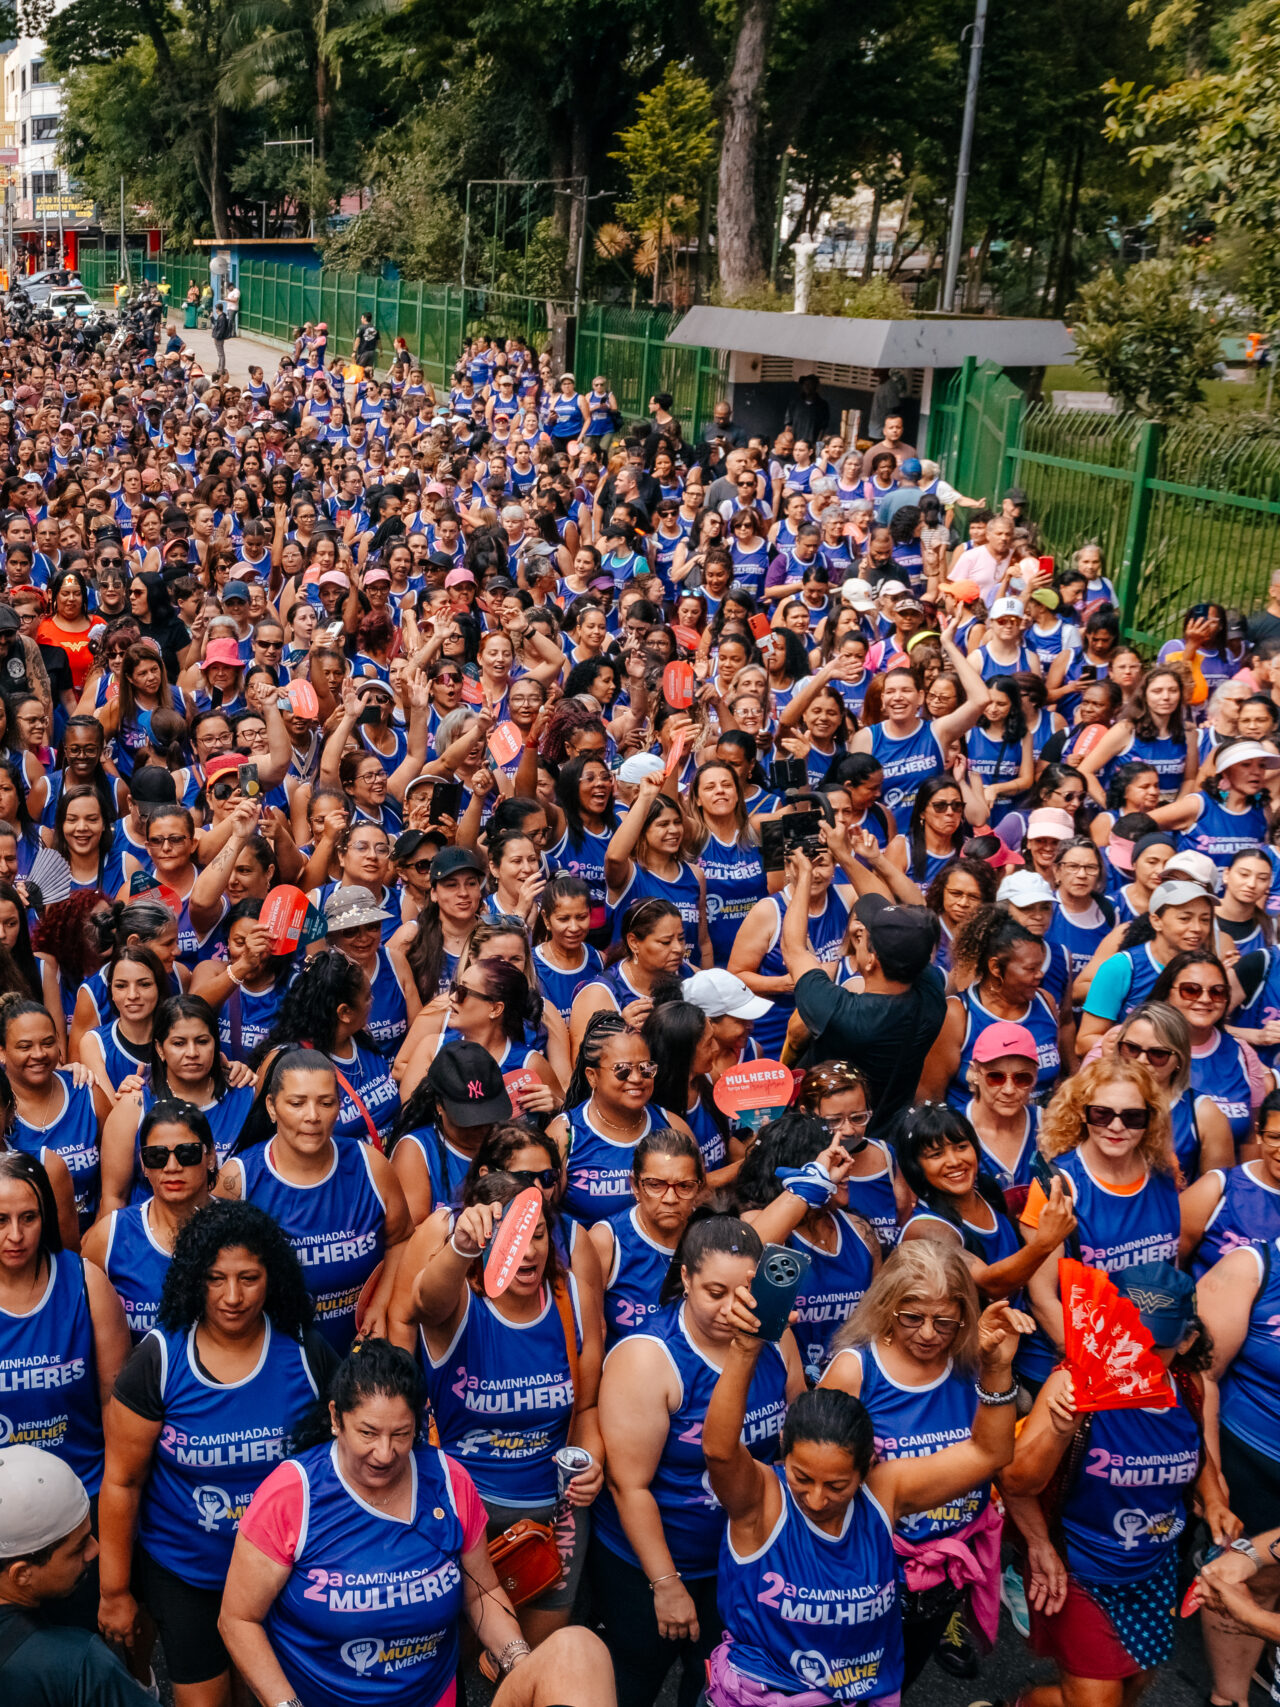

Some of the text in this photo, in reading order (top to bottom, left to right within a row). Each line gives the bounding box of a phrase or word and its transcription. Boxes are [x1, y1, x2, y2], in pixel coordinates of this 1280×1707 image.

[700, 861, 762, 879] MULHERES
[505, 1074, 531, 1093] ERES
[726, 1070, 785, 1085] MULHERES
[289, 1231, 345, 1246] AMINHADA
[498, 1200, 538, 1288] MULHERES
[1107, 1234, 1163, 1255] CAMINHADA
[296, 1232, 376, 1266] LHERES
[50, 1355, 60, 1363] DE
[480, 1375, 553, 1391] CAMINHADA
[554, 1374, 563, 1382] DE
[464, 1379, 574, 1414] MULHERE
[190, 1428, 270, 1445] CAMINHADA
[272, 1427, 283, 1435] DE
[177, 1436, 292, 1466] MULHER
[1110, 1464, 1198, 1486] MULHER
[329, 1561, 460, 1611] MULHERES
[798, 1584, 875, 1600] CAMINHADA
